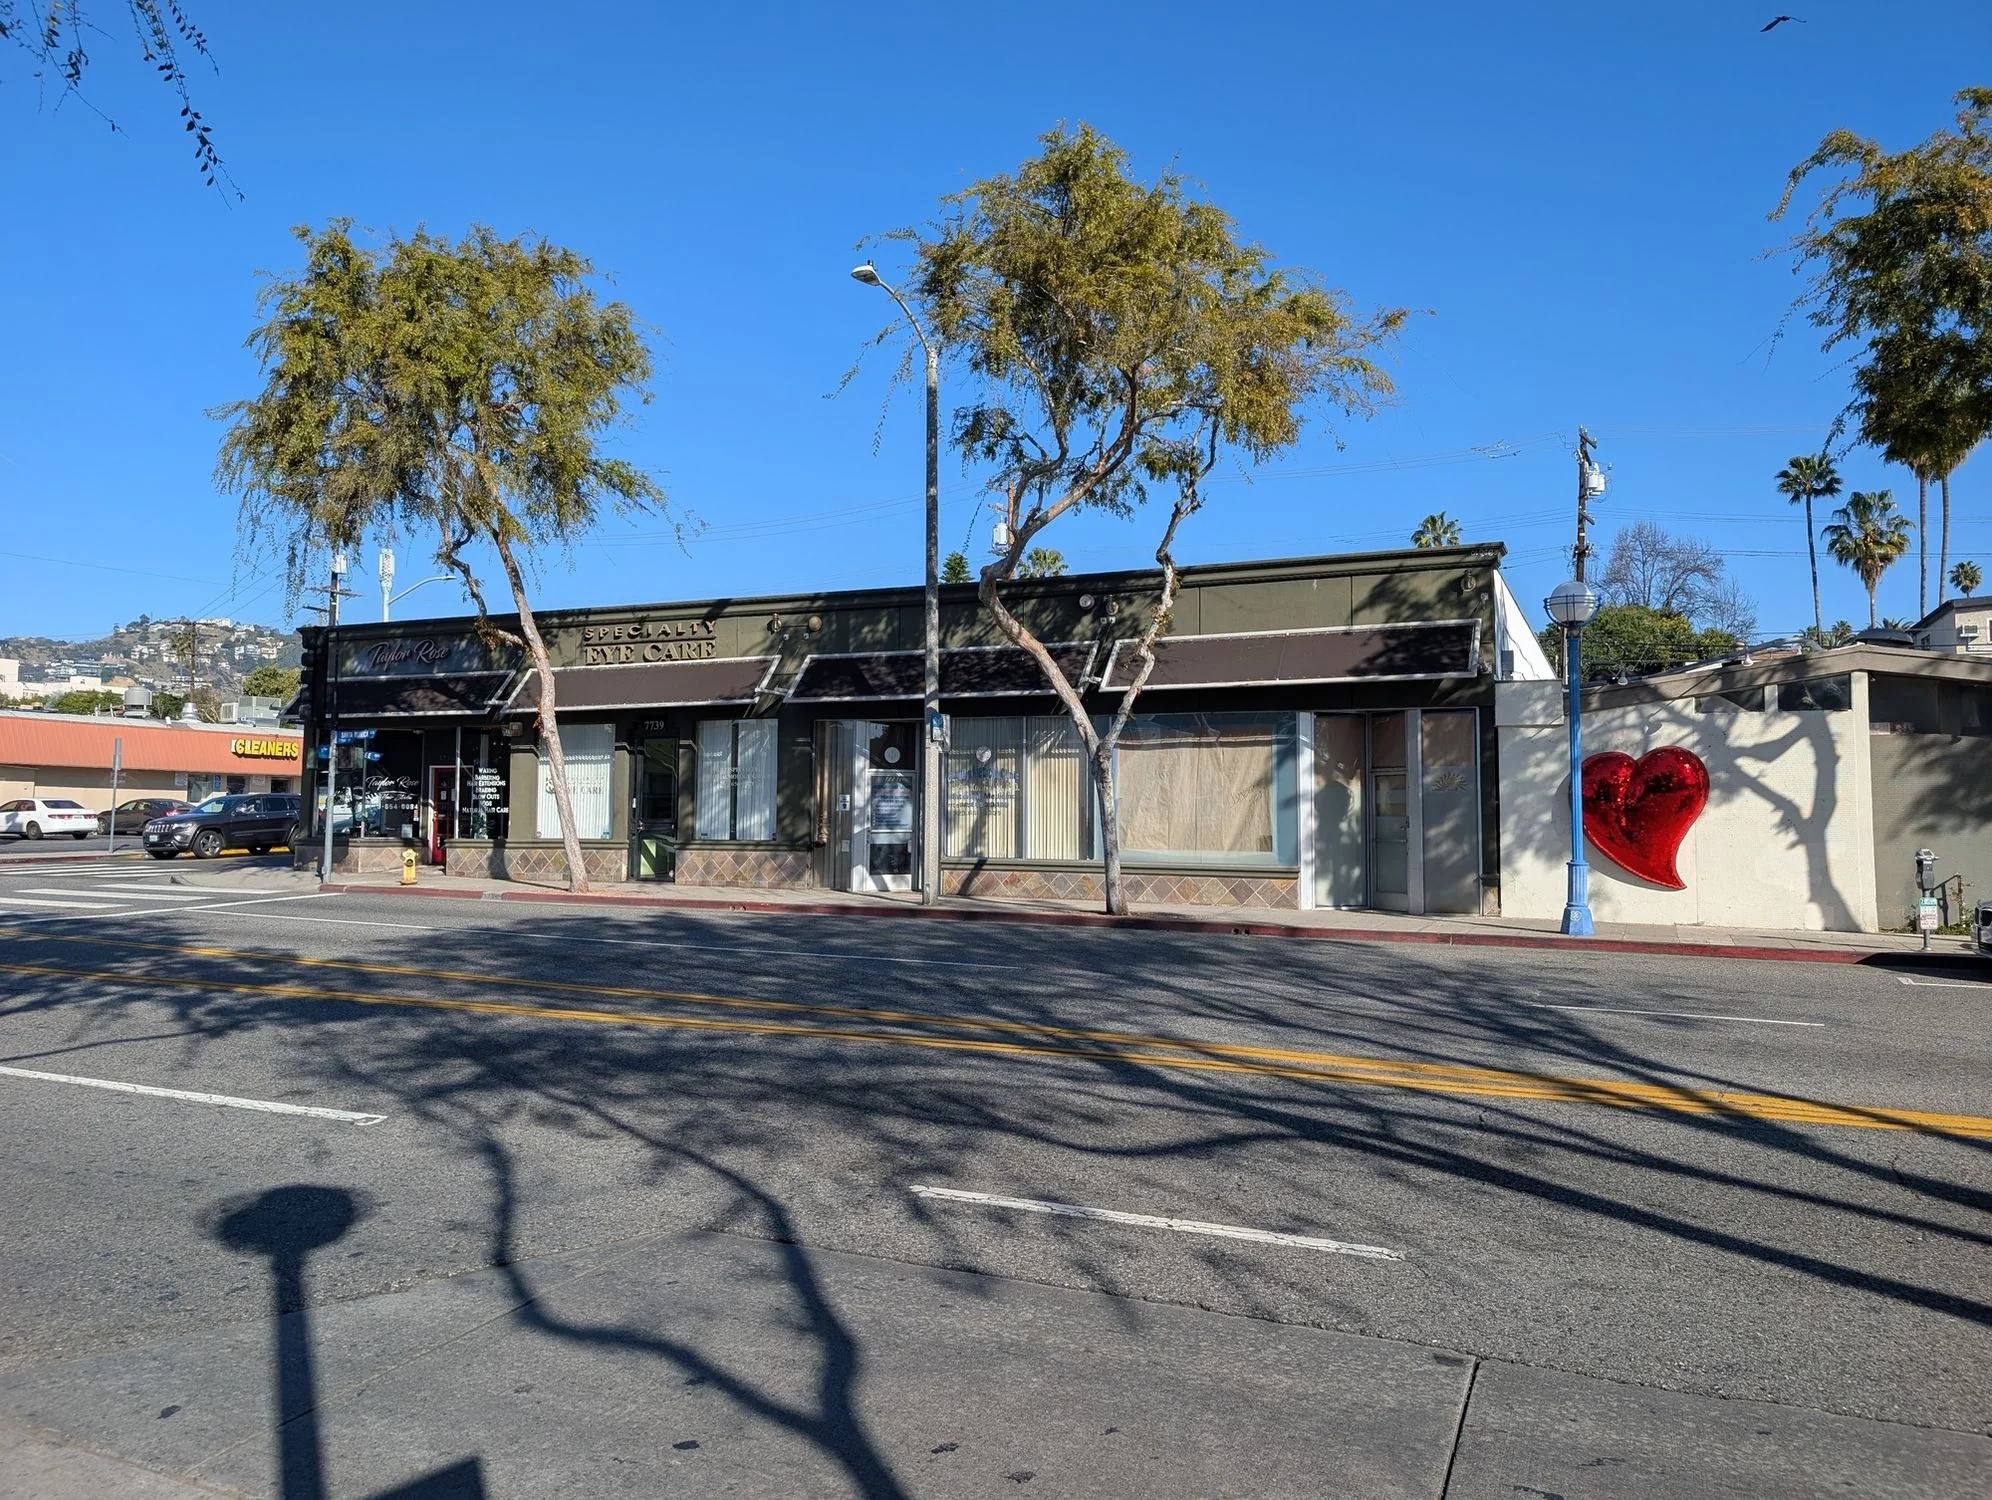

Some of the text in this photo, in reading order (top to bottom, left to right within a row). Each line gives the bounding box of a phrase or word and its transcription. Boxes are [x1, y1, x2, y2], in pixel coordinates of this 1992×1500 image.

[584, 620, 716, 640] SPECIALTY
[368, 639, 450, 671] Taylor Rose
[584, 640, 717, 664] EYE CARE
[644, 720, 665, 730] 7739
[234, 739, 299, 758] CLEANERS
[365, 775, 420, 791] Taylor Rose
